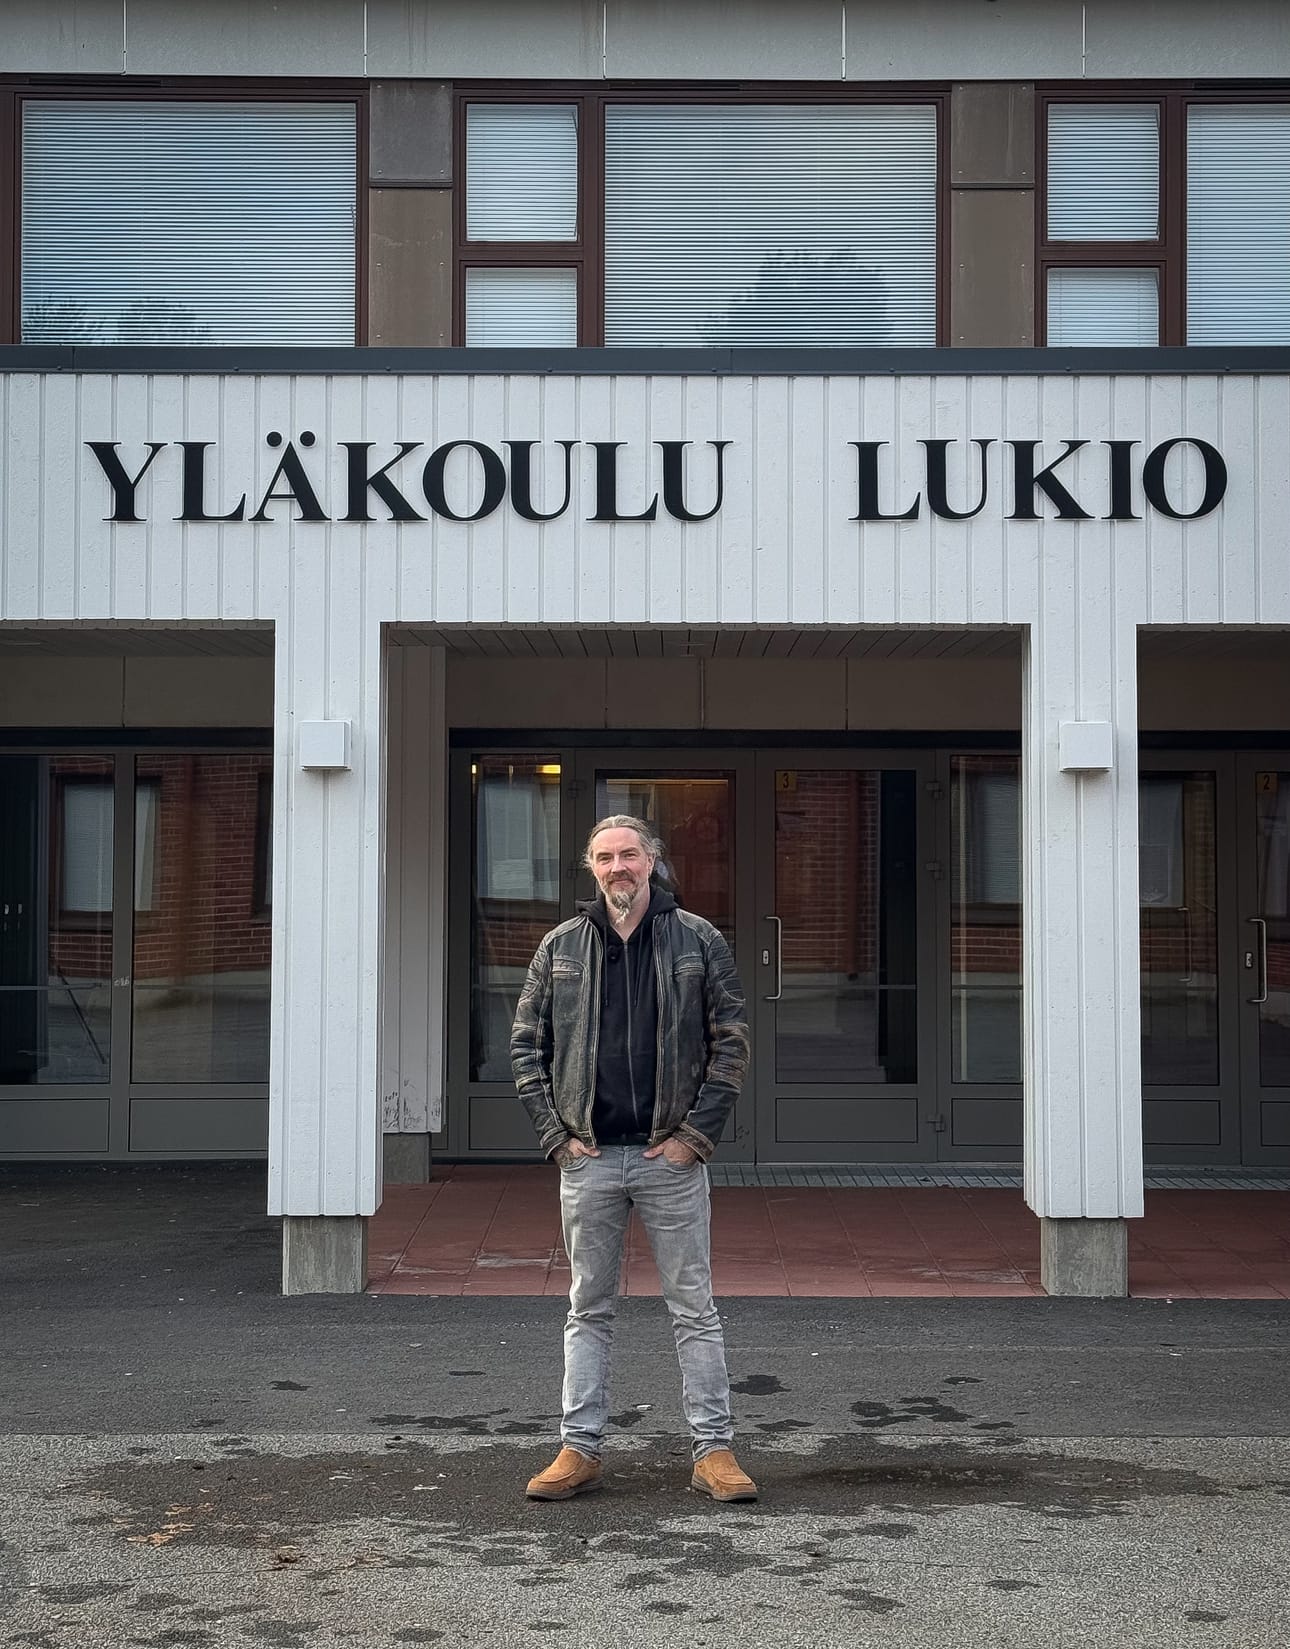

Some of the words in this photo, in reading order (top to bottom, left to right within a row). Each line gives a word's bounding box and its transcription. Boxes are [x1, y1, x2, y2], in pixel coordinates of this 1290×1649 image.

[83, 430, 734, 522] YLÄKOULU
[847, 437, 1228, 521] LUKIO
[782, 772, 790, 789] 3
[1263, 774, 1271, 790] 2
